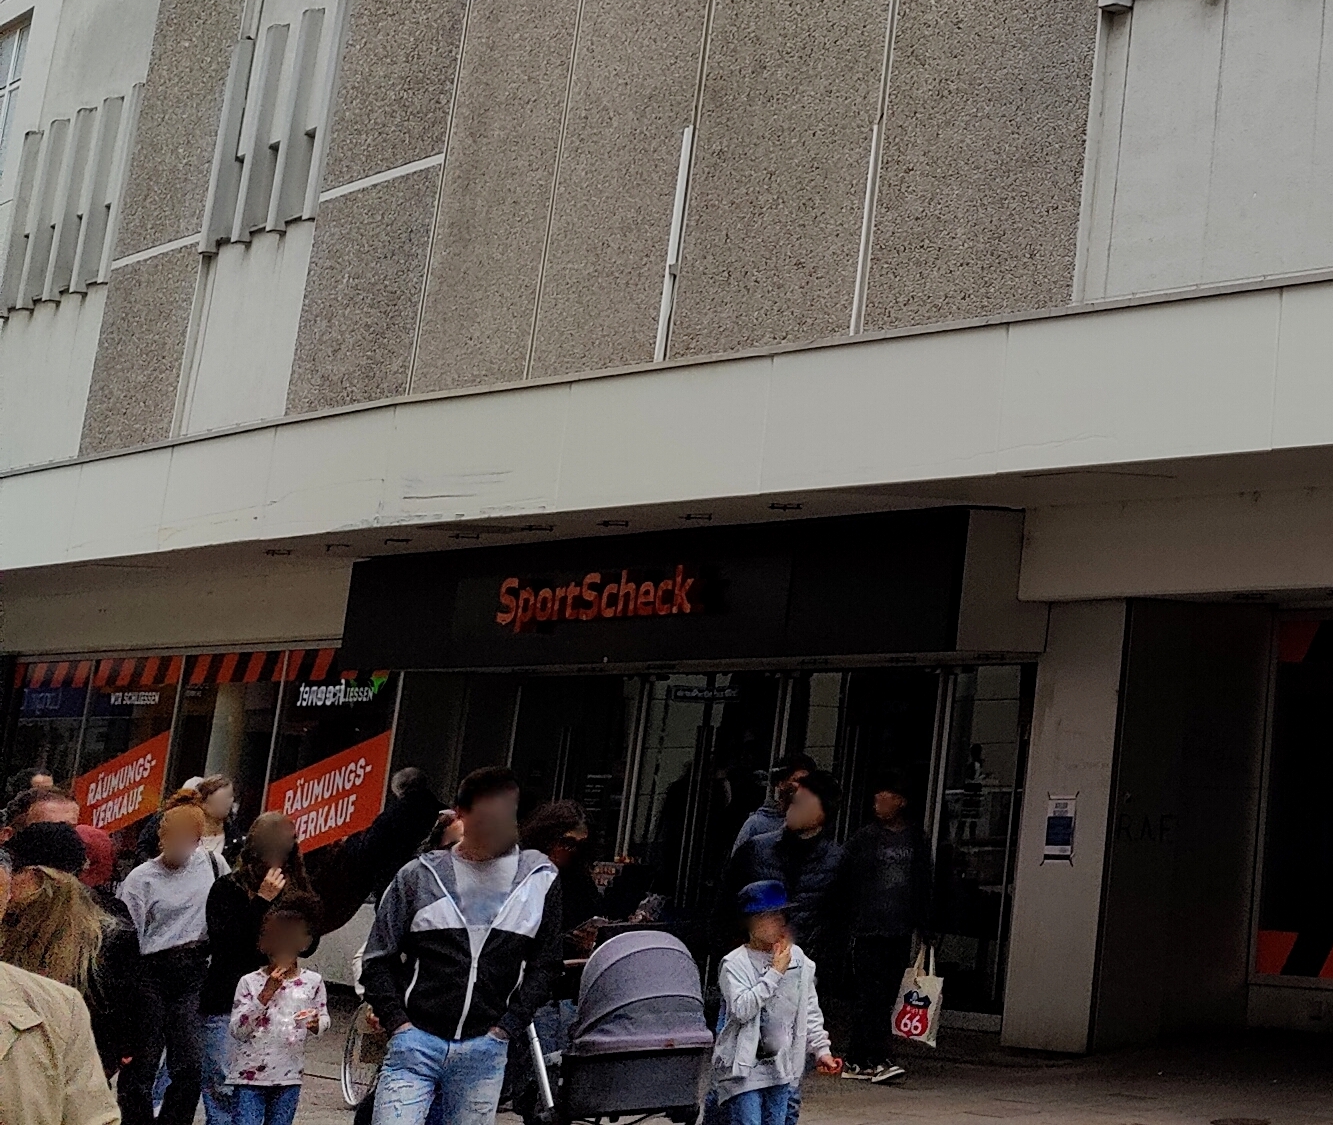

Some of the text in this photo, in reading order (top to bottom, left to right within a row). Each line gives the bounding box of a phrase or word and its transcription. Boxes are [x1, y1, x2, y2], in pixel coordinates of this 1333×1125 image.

[495, 564, 696, 634] SportScheck
[110, 691, 160, 705] WIR SCHLIESSEN
[87, 753, 157, 807] RÄUMUNGS-
[283, 757, 373, 815] RÄUMUNGS-
[92, 784, 145, 829] VERKAUF
[900, 1013, 922, 1034] 66
